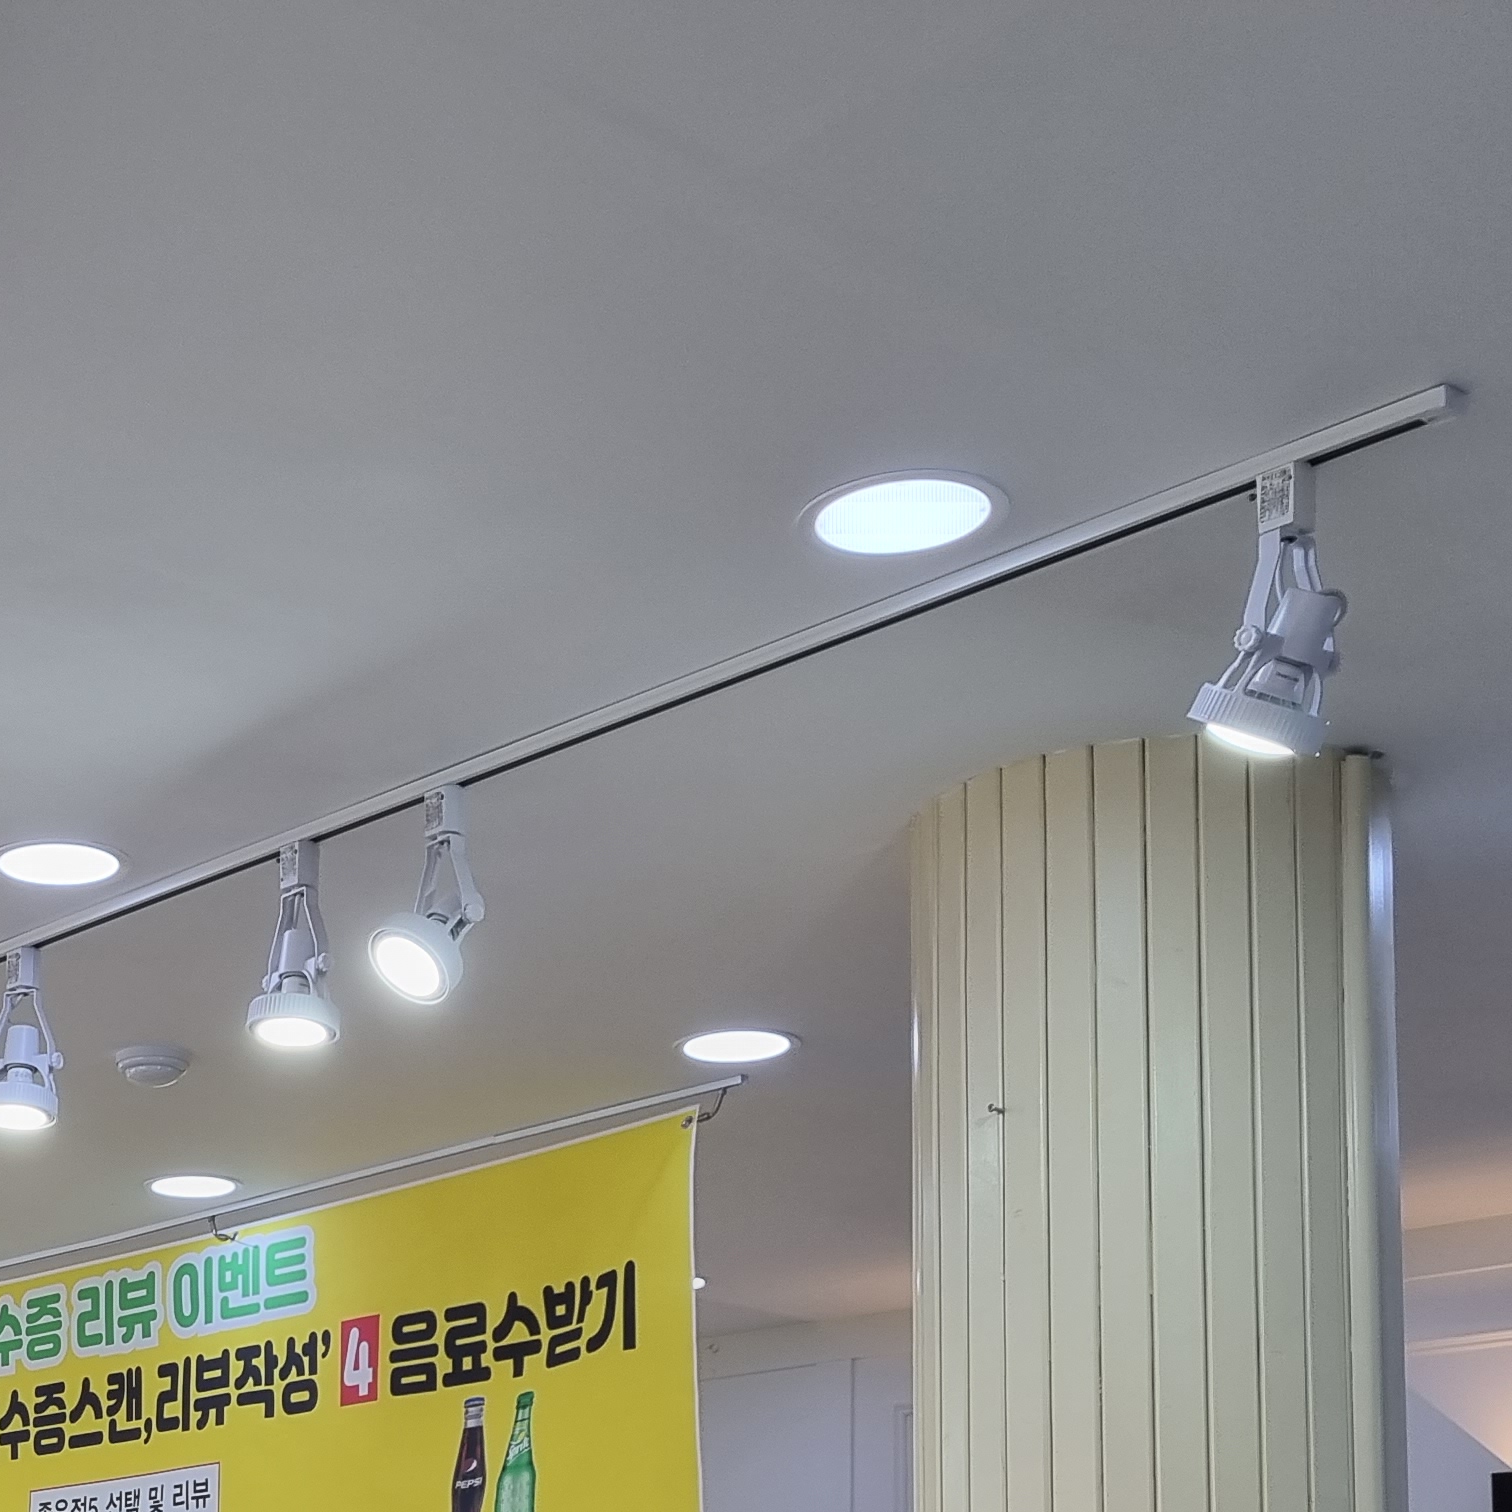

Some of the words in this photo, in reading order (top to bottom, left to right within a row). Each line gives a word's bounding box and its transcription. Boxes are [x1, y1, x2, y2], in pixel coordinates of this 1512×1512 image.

[77, 1270, 158, 1350] 리뷰
[172, 1234, 311, 1327] 이벤트
[343, 1326, 375, 1398] 4
[388, 1260, 638, 1398] 음료수받기
[172, 1476, 212, 1511] 리뷰
[455, 1477, 483, 1489] PEPSI
